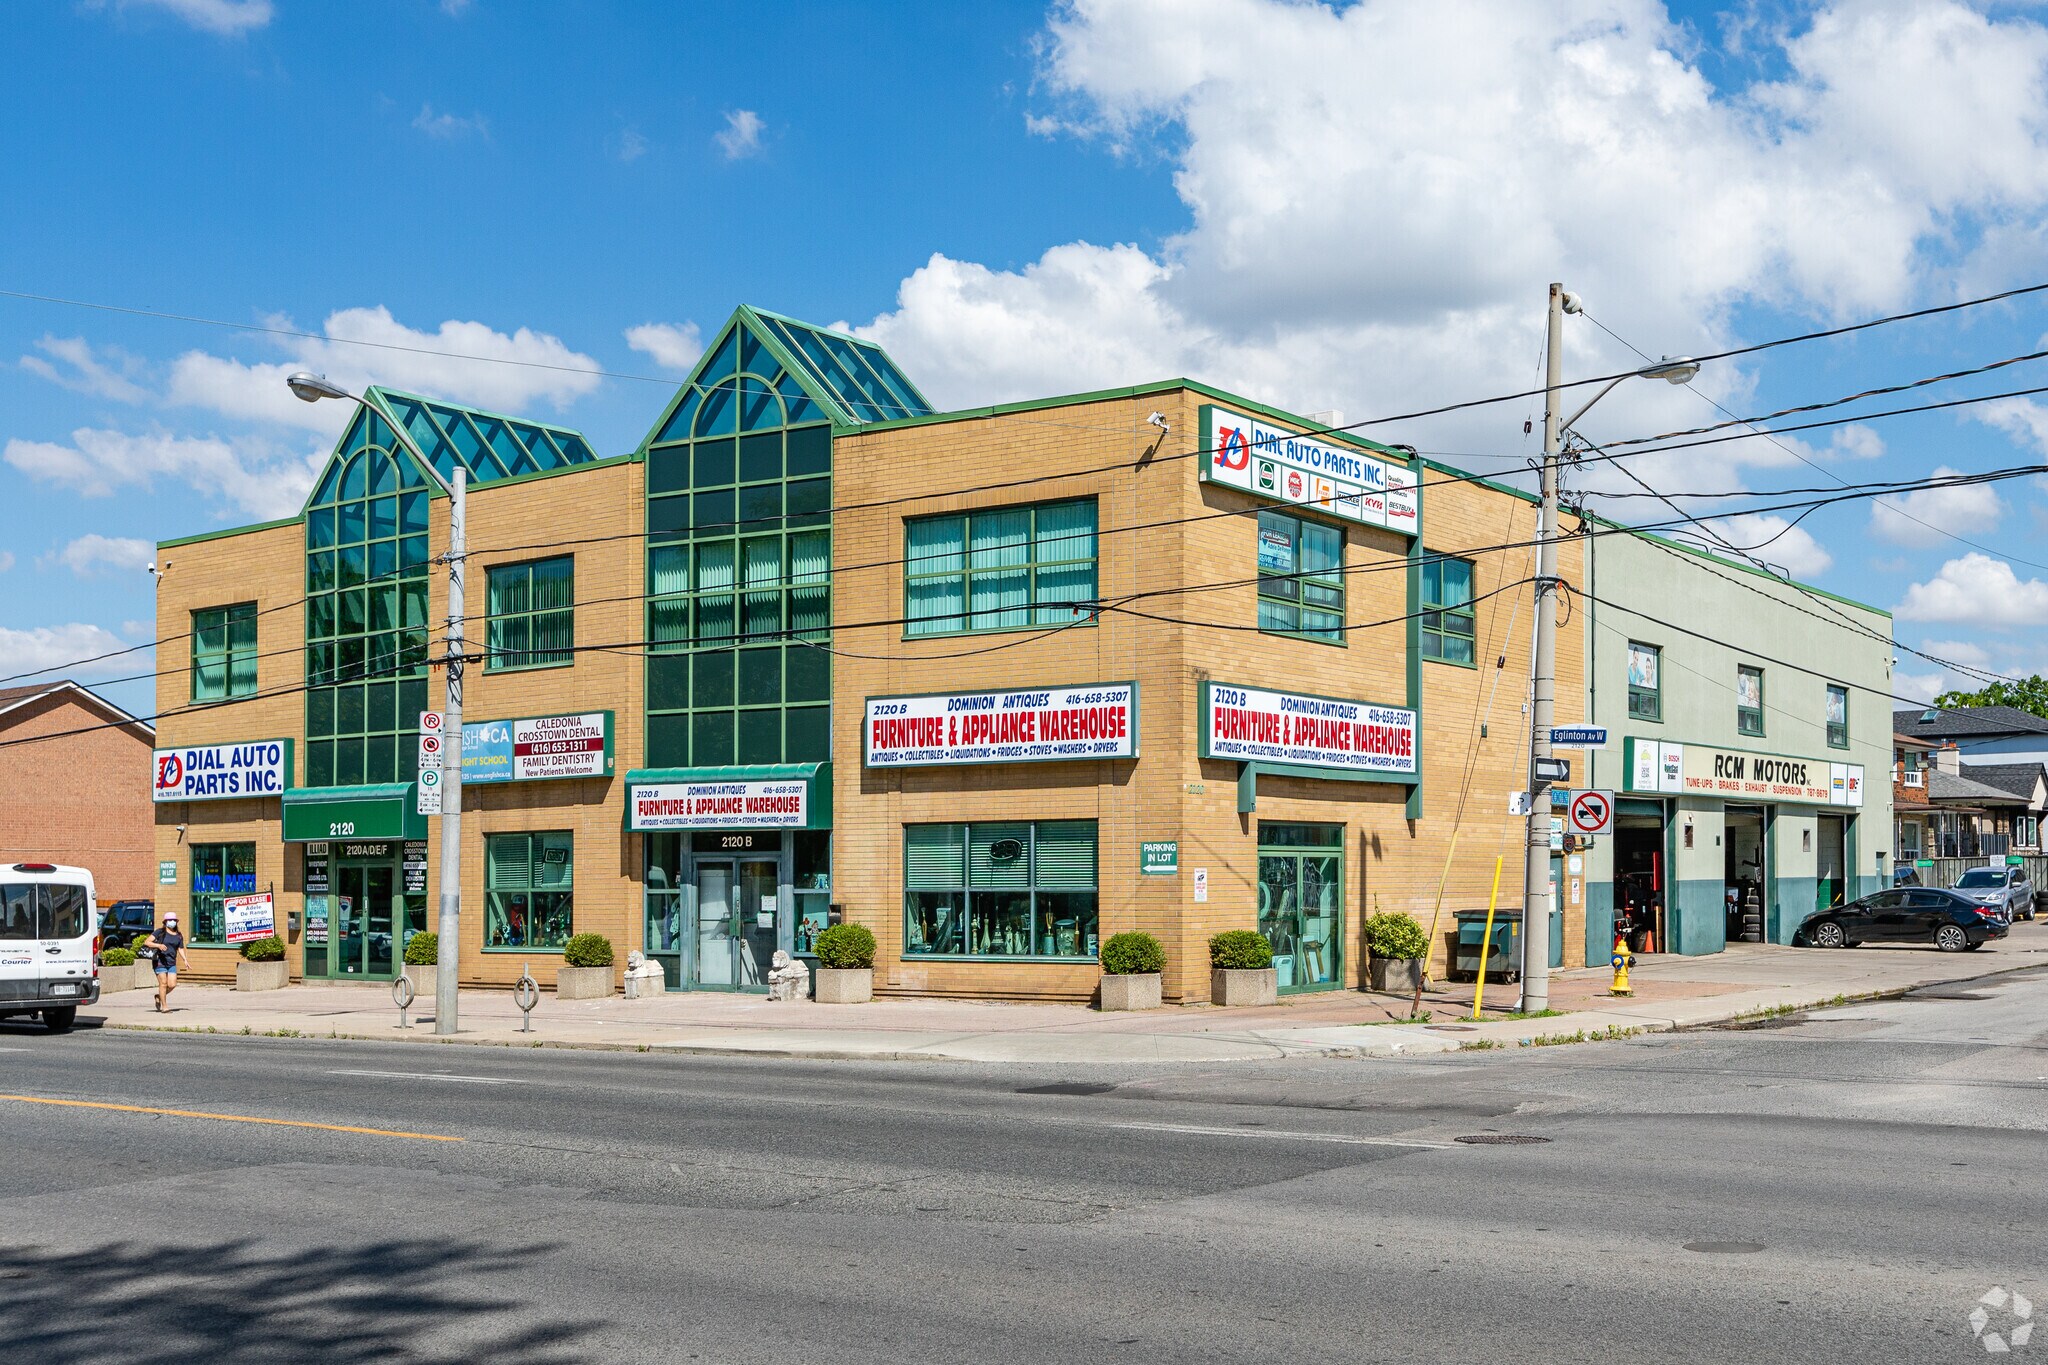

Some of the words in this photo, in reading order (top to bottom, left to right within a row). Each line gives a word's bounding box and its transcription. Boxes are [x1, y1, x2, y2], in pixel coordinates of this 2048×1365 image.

[1255, 429, 1283, 455] DIAL
[1287, 440, 1321, 466] AUTO
[1324, 453, 1360, 479] PARTS
[1364, 465, 1384, 486] INC.
[873, 705, 897, 716] 2120
[899, 704, 907, 714] B
[947, 696, 995, 712] DOMINION
[1002, 693, 1049, 709] ANTIQUES
[1065, 691, 1128, 705] 416-658-5307
[1215, 688, 1237, 706] 2120
[1240, 693, 1246, 706] B
[1281, 697, 1319, 715] DOMINION
[1321, 702, 1357, 720] ANTIQUES
[1369, 708, 1411, 726] 416-658-5307
[535, 717, 581, 729] CALEDONIA
[873, 716, 943, 749] FURNITURE
[950, 716, 958, 746] &
[962, 711, 1035, 745] APPLIANCE
[1039, 706, 1126, 740] WAREHOUSE
[1214, 707, 1279, 744] FURNITURE
[1283, 715, 1291, 746] &
[1294, 716, 1350, 750] APPLIANCE
[1353, 723, 1411, 756] WAREHOUSE
[518, 729, 568, 742] CROSSTOWN
[569, 727, 600, 737] DENTAL
[1554, 730, 1586, 741] Eglinton
[1596, 731, 1604, 739] W
[531, 742, 550, 754] (416)
[552, 741, 588, 752] 653-1311
[870, 752, 898, 763] ANTIQUES
[905, 750, 944, 761] COLLECTIBLES
[950, 748, 991, 760] LIQUIDATIONS
[997, 746, 1022, 757] FRIDGES
[1029, 744, 1051, 755] STOVES
[1058, 743, 1086, 754] WASHERS
[1093, 742, 1118, 752] DRYERS
[1214, 741, 1242, 753] ANTIQUES
[1247, 745, 1283, 757] COLLECTIBLES
[1288, 748, 1321, 761] LIQUIDATIONS
[1326, 752, 1345, 763] FRIDGES
[1350, 755, 1367, 764] STOVES
[1372, 757, 1391, 766] WASHERS
[1395, 759, 1411, 768] DRYERS
[186, 749, 224, 771] DIAL
[231, 744, 280, 767] AUTO
[479, 755, 508, 766] SCHOOL
[523, 757, 550, 767] FAMILY
[552, 753, 595, 765] DENTISTRY
[525, 769, 538, 777] New
[540, 767, 564, 776] Patients
[566, 766, 592, 774] Welcome
[1714, 754, 1745, 779] RCM
[1753, 759, 1806, 785] MOTORS
[185, 772, 239, 795] PARTS
[246, 770, 281, 792] INC.
[688, 786, 717, 796] DOMINION
[717, 785, 746, 795] ANTIQUES
[763, 786, 802, 794] 416-658-5307
[1686, 777, 1713, 789] TUNE-UPS
[1718, 780, 1740, 791] BRAKES
[1744, 783, 1767, 793] EXHAUST
[1772, 785, 1802, 796] SUSPENSION
[638, 799, 684, 816] FURNITURE
[686, 799, 692, 815] &
[695, 797, 742, 815] APPLIANCE
[746, 796, 800, 813] WAREHOUSE
[330, 822, 354, 835] 2120
[722, 837, 743, 847] 2120
[745, 836, 752, 846] B
[1148, 854, 1155, 862] IN
[1157, 854, 1172, 862] LOT
[194, 875, 220, 892] AUTO
[225, 874, 256, 892] PARTS
[248, 896, 266, 904] LEASE
